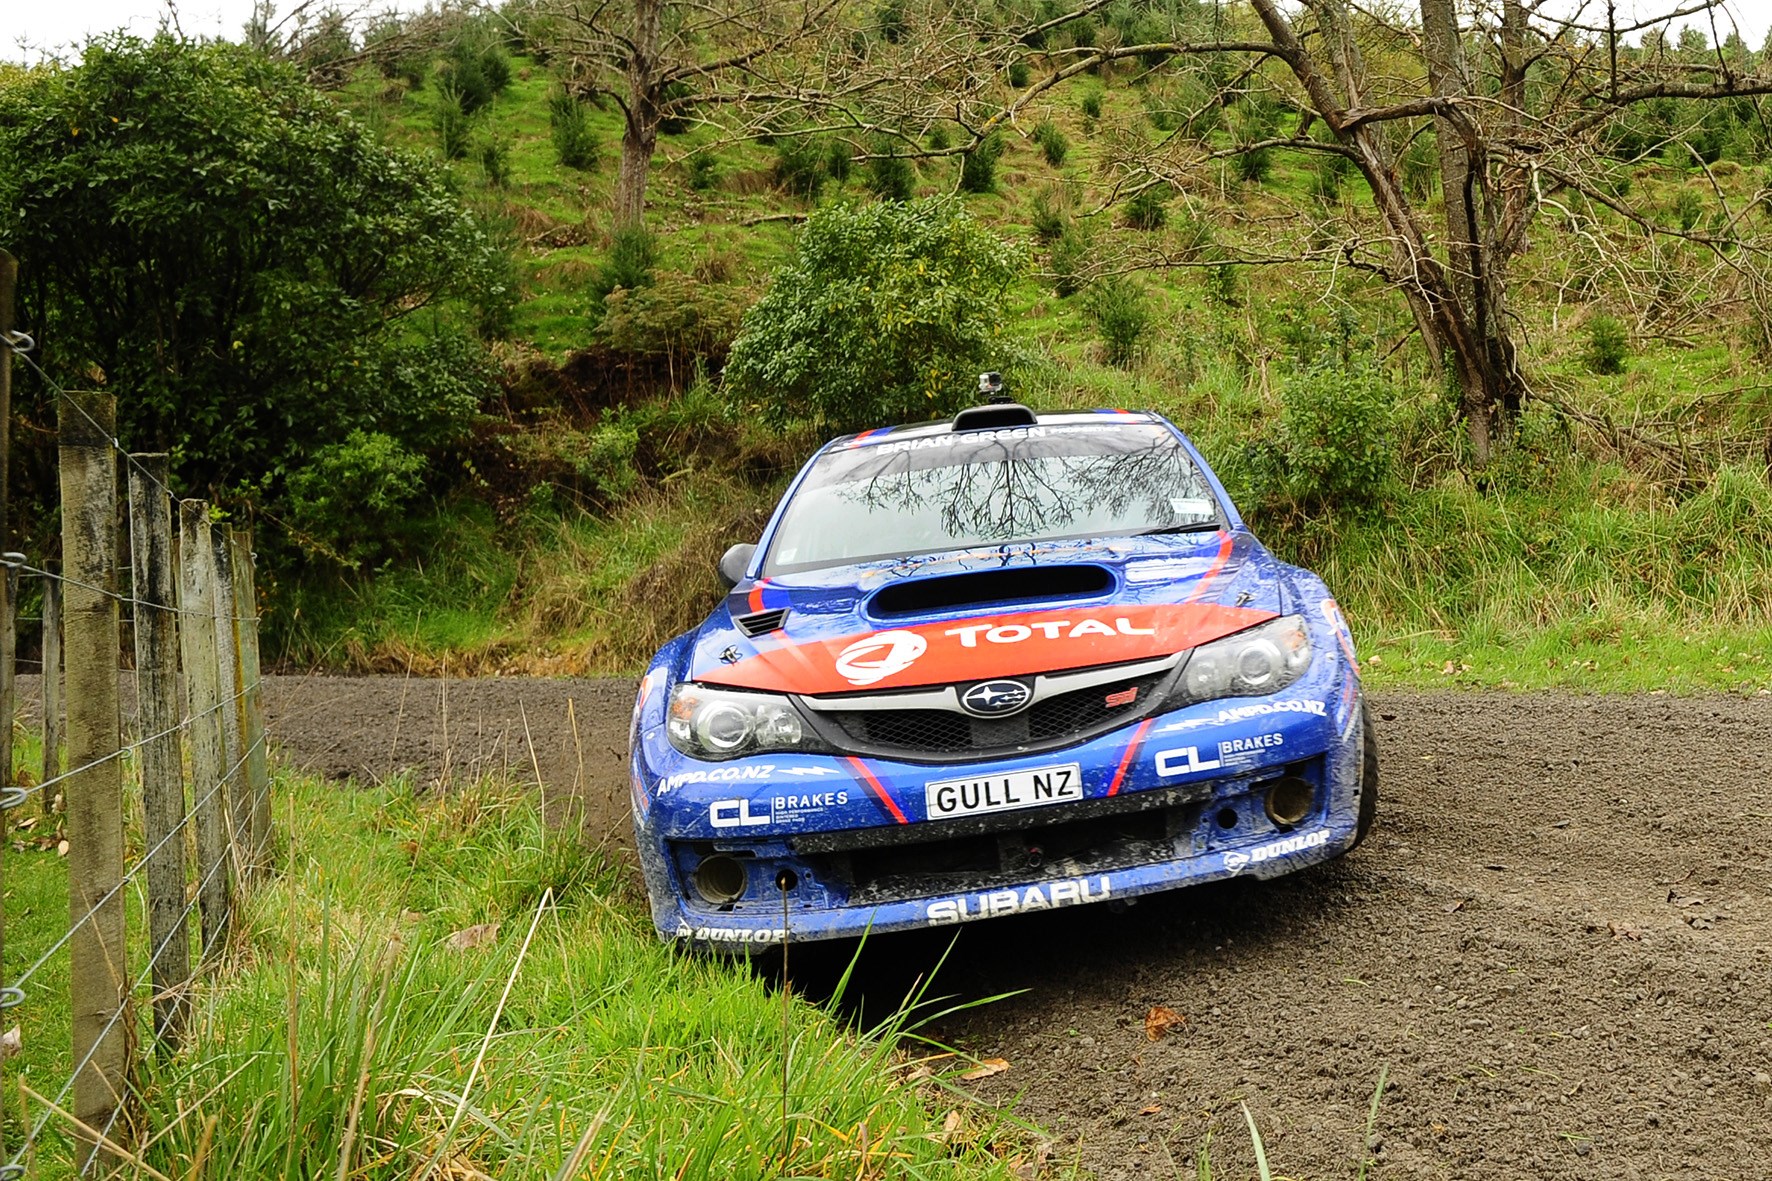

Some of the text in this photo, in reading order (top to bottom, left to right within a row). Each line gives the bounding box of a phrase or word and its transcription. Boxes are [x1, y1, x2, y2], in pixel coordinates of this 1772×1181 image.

[876, 434, 954, 455] BRIAN
[960, 427, 1046, 444] GREEN
[945, 618, 1155, 647] TOTAL
[1155, 733, 1284, 777] CL BRAKES
[656, 765, 776, 796] AMPD.CO.NZ
[937, 771, 1073, 812] GULL NZ
[710, 791, 848, 828] CL BRAKES
[1251, 830, 1330, 861] DUNLOP
[927, 876, 1111, 926] SUBARU
[695, 927, 790, 942] DUNLOP
